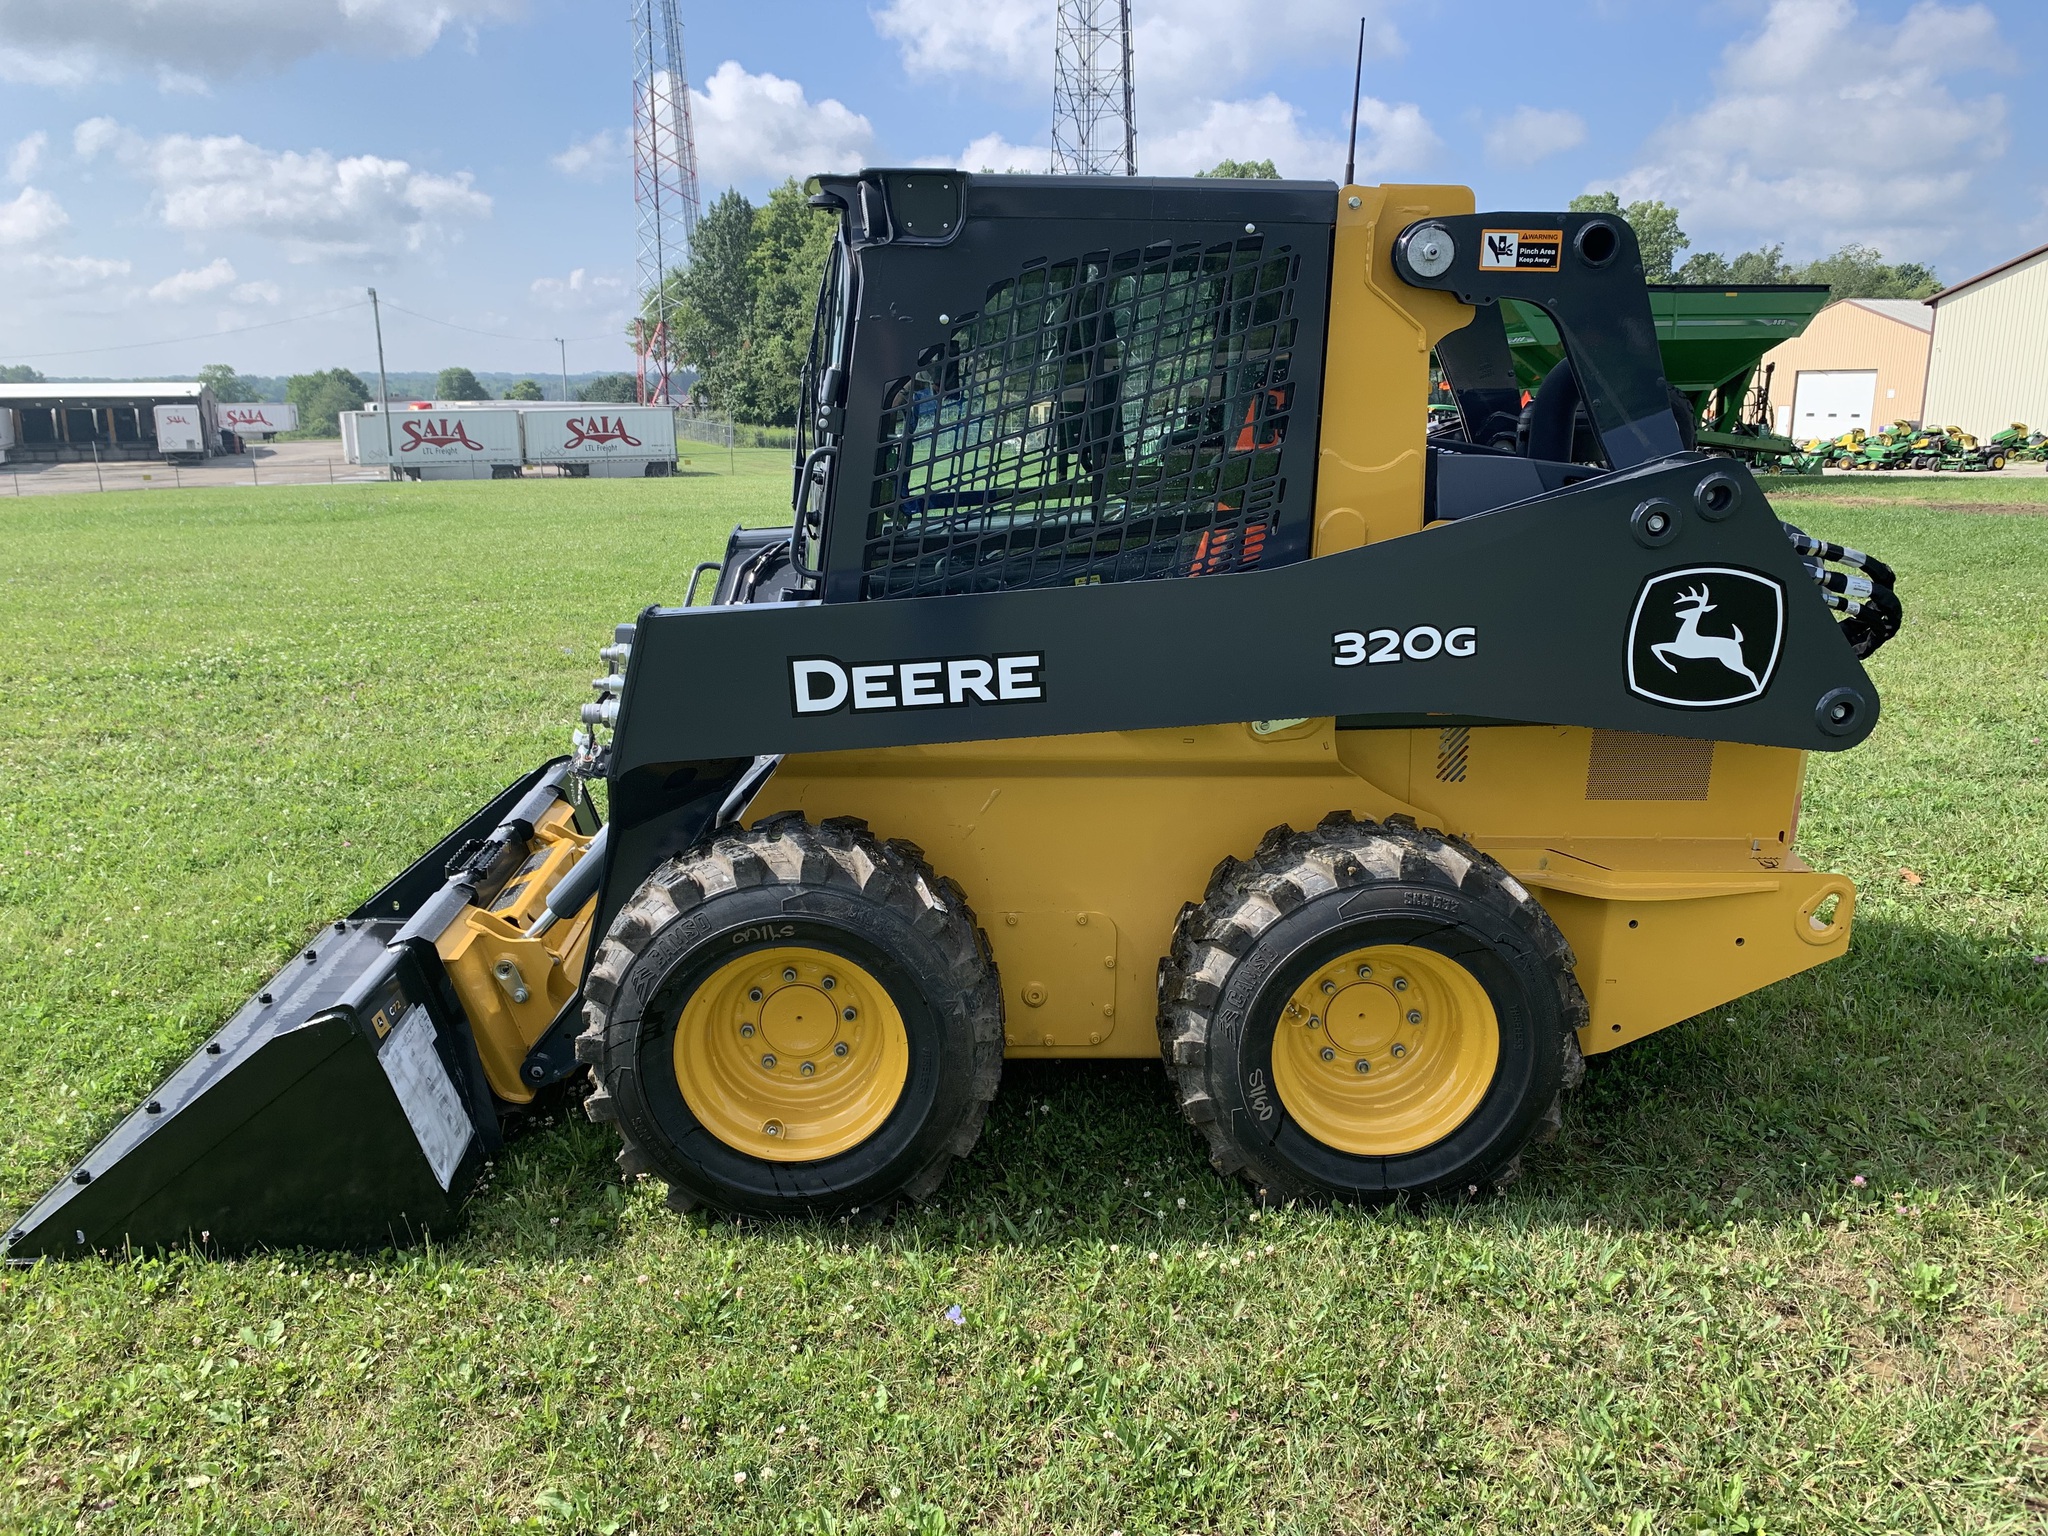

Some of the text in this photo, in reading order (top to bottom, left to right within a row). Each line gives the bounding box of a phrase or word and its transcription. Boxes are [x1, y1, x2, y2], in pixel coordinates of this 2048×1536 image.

[1519, 247, 1539, 255] Pinch
[1534, 256, 1551, 264] Away
[166, 415, 190, 425] SAIA
[226, 408, 274, 427] SAIA
[400, 418, 485, 452] SAIA
[563, 415, 642, 449] SAIA
[422, 447, 458, 456] LTL Freight
[585, 444, 618, 452] LTL Freight
[1333, 625, 1476, 666] 320G
[792, 655, 1042, 713] DEERE
[1226, 941, 1279, 1009] CAMSO
[388, 1000, 402, 1016] C72
